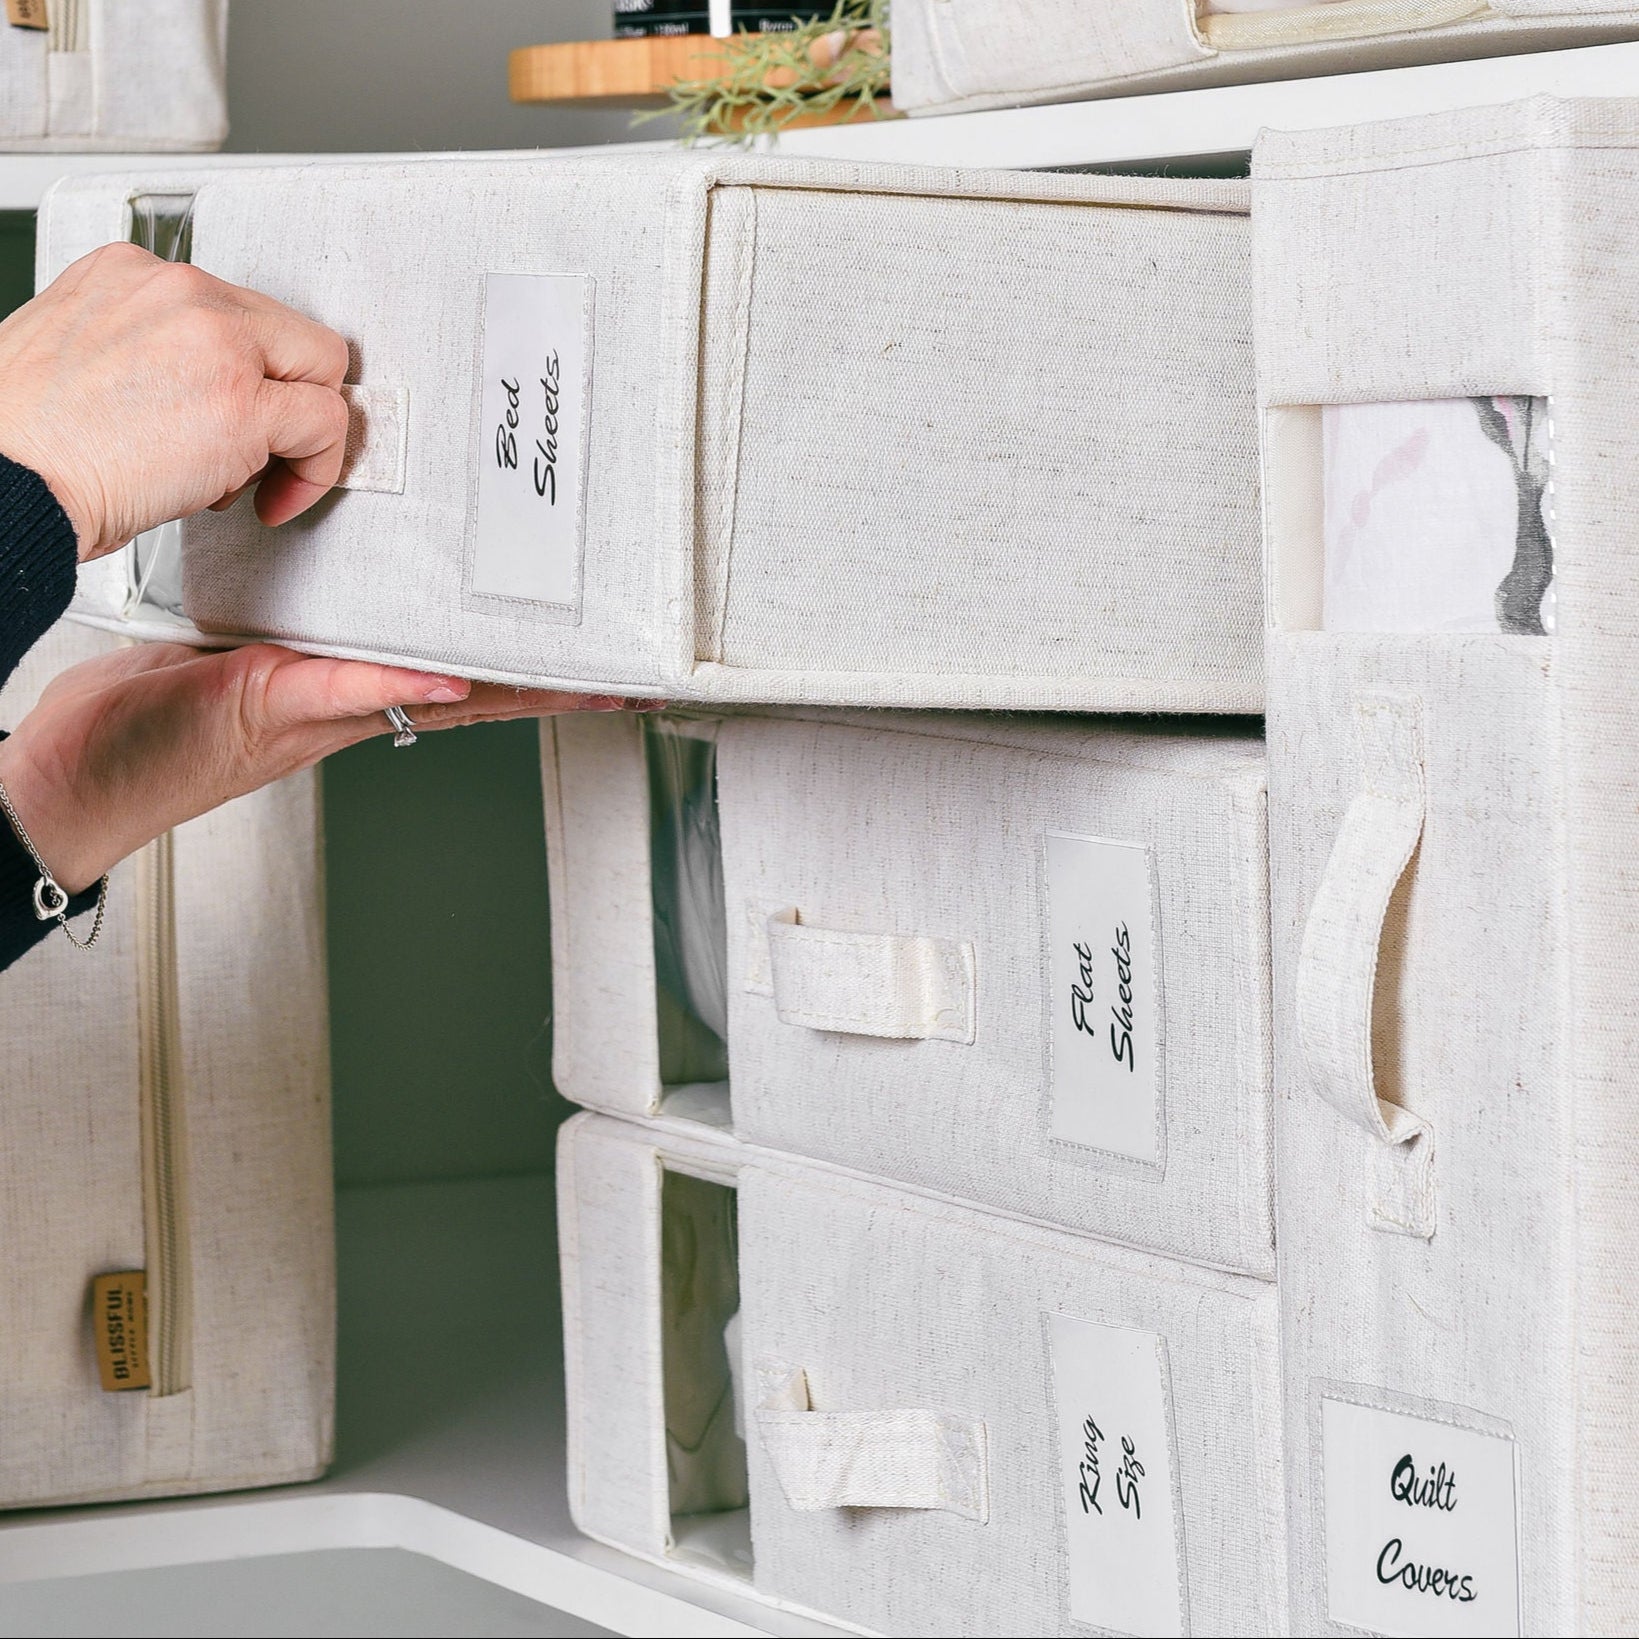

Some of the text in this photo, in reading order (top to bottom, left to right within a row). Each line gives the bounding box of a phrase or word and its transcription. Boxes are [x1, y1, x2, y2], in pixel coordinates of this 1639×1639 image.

[496, 379, 520, 470] Bed
[533, 351, 560, 506] Sheets
[1071, 943, 1095, 1037] Flat
[1110, 922, 1134, 1073] Sheets
[106, 1284, 130, 1380] BLISSFUL
[1079, 1415, 1105, 1515] King
[1116, 1436, 1145, 1520] Size
[1390, 1453, 1457, 1512] Quilt
[1376, 1538, 1476, 1602] Covers
